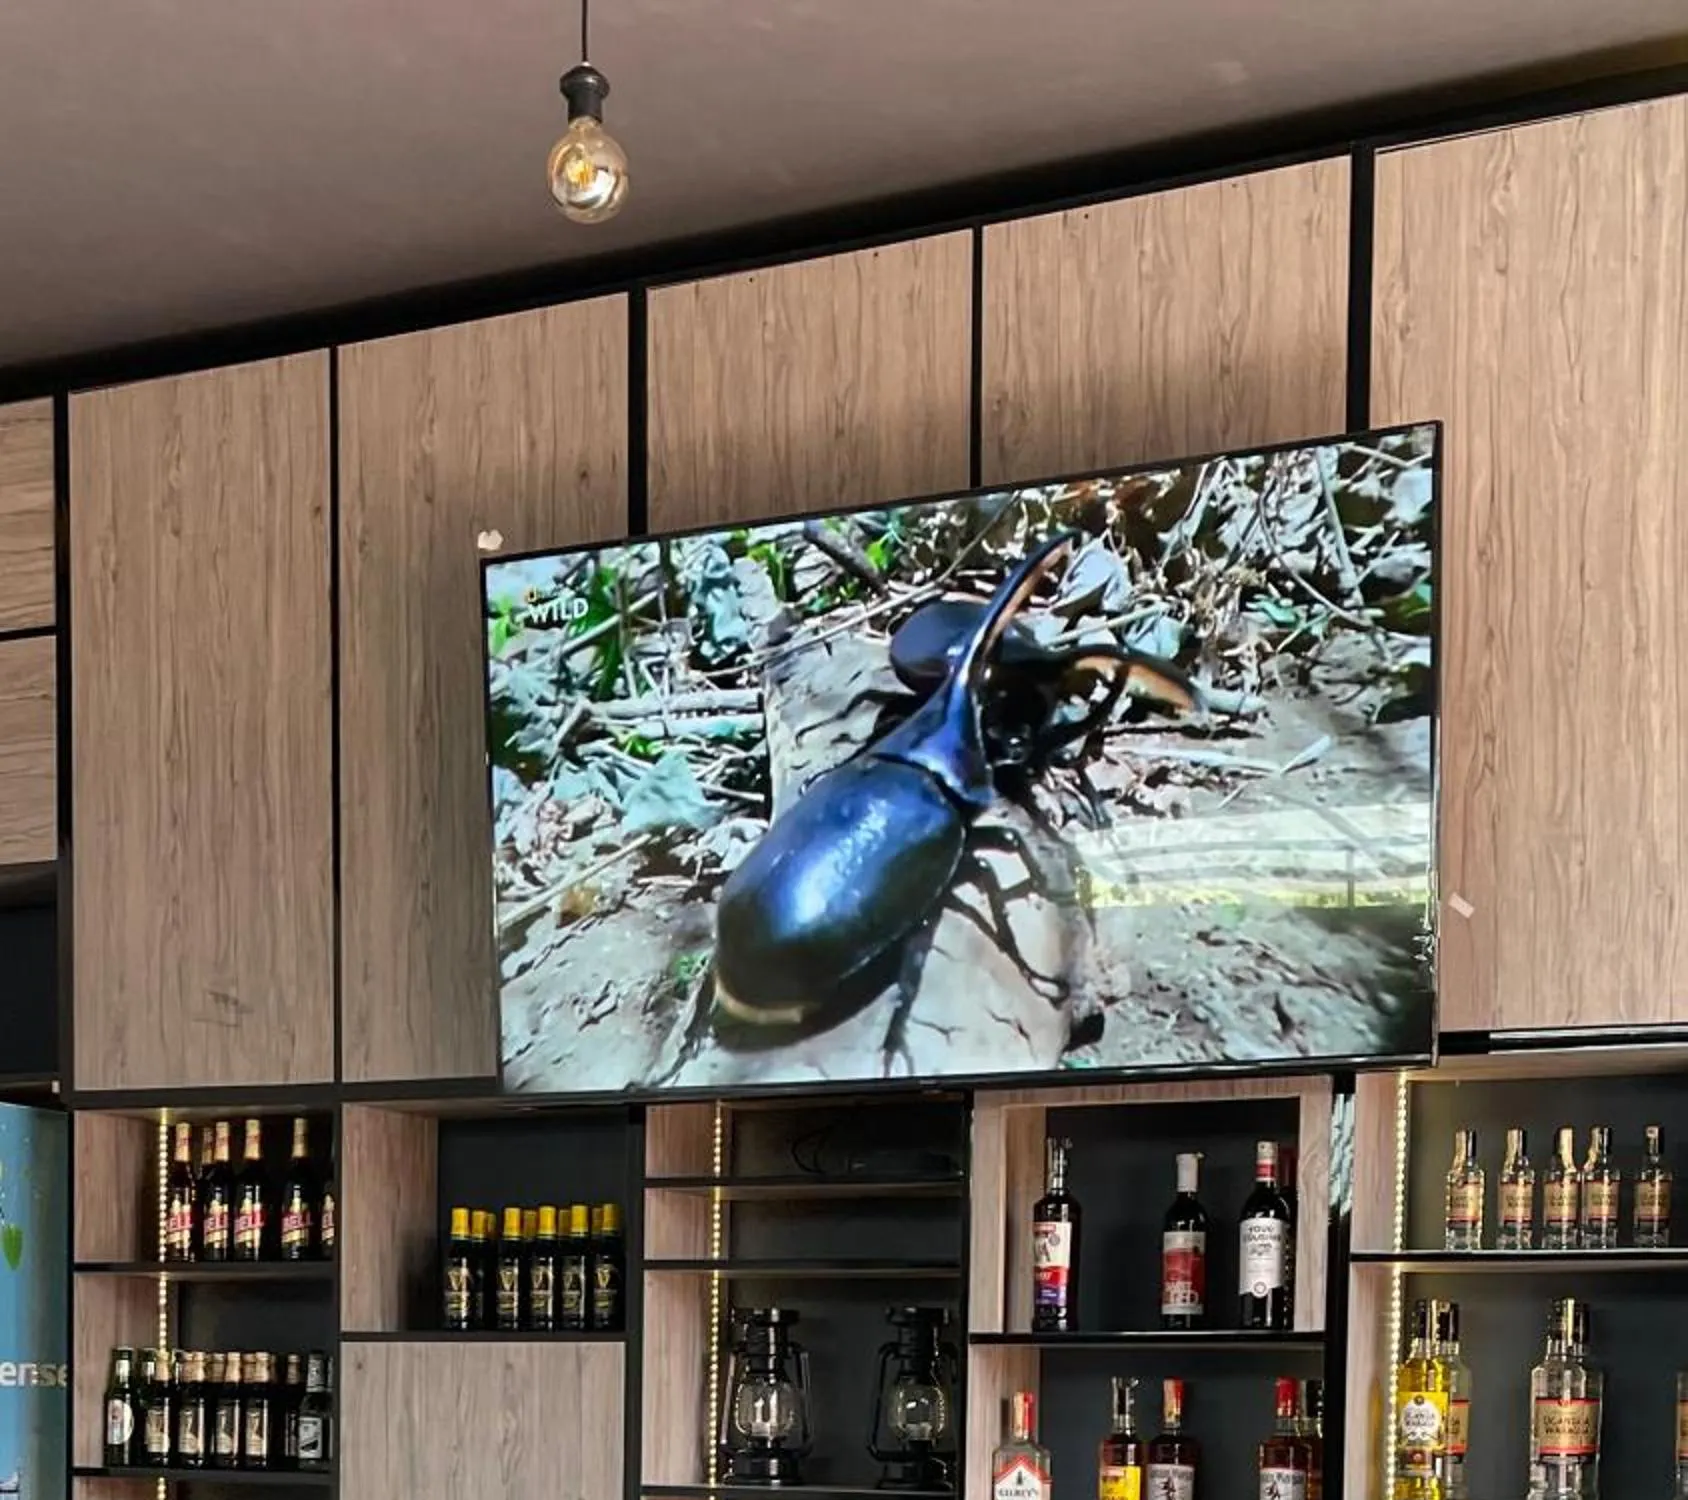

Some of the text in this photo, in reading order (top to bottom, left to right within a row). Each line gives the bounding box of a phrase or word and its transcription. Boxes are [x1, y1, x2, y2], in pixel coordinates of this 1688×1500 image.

[528, 598, 589, 623] WILD
[235, 1210, 264, 1233] BELL
[283, 1212, 314, 1232] BELL
